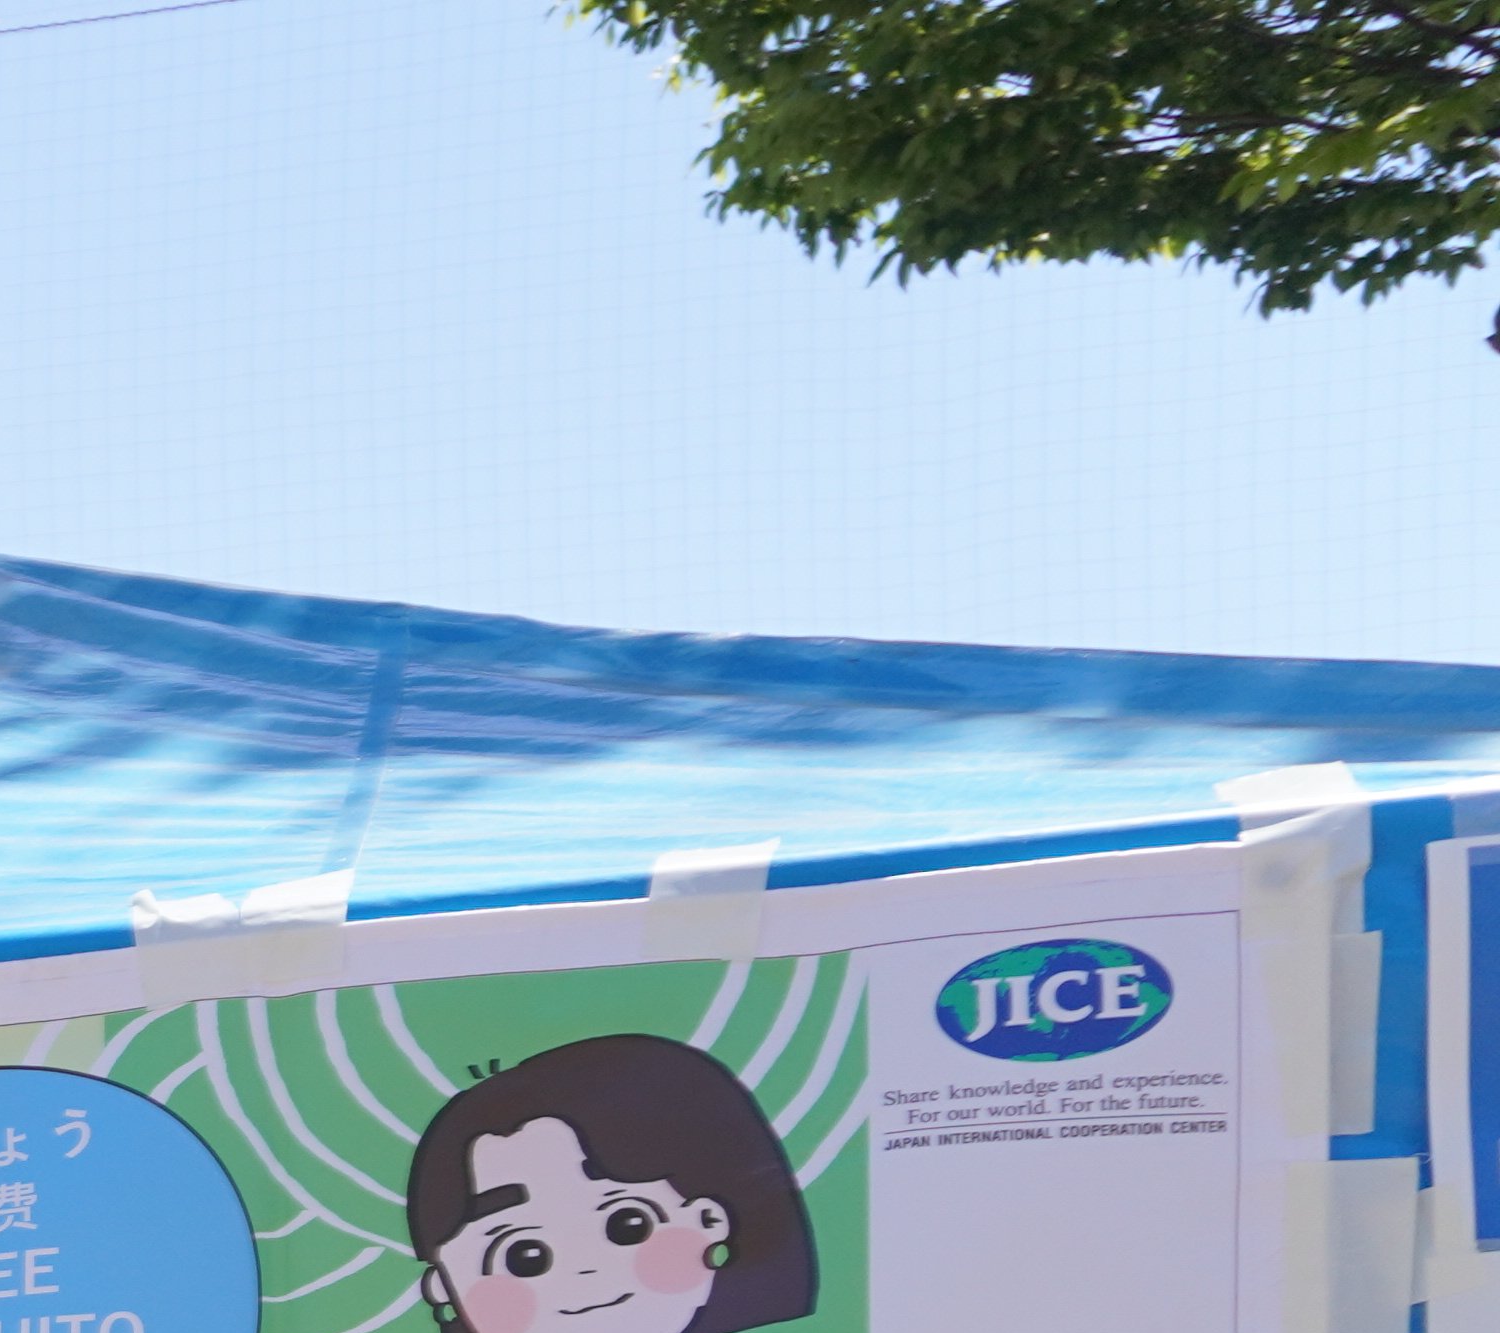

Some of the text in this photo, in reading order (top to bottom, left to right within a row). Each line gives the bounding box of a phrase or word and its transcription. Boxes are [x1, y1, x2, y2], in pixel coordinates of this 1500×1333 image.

[966, 964, 1148, 1042] JICE
[883, 1070, 1229, 1107] Share knowledge and experience.
[907, 1091, 1204, 1124] For our world. For the future.
[884, 1118, 1227, 1151] JAPAN INTERNATIONAL COOPERATION CENTER
